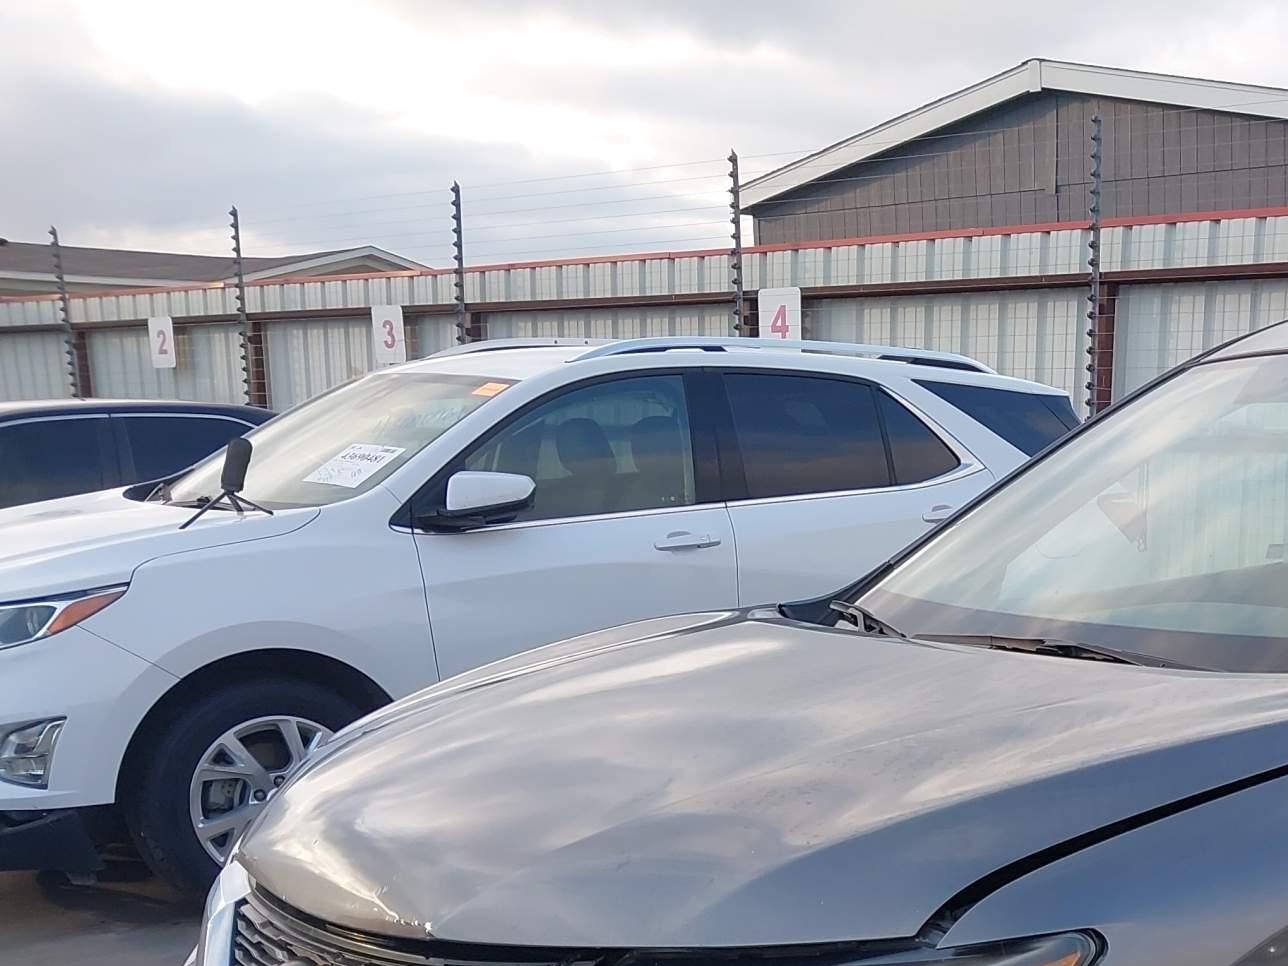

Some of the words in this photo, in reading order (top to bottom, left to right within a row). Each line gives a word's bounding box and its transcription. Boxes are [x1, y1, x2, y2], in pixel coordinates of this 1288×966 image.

[382, 319, 396, 349] 3
[771, 304, 790, 339] 4
[156, 329, 169, 354] 2
